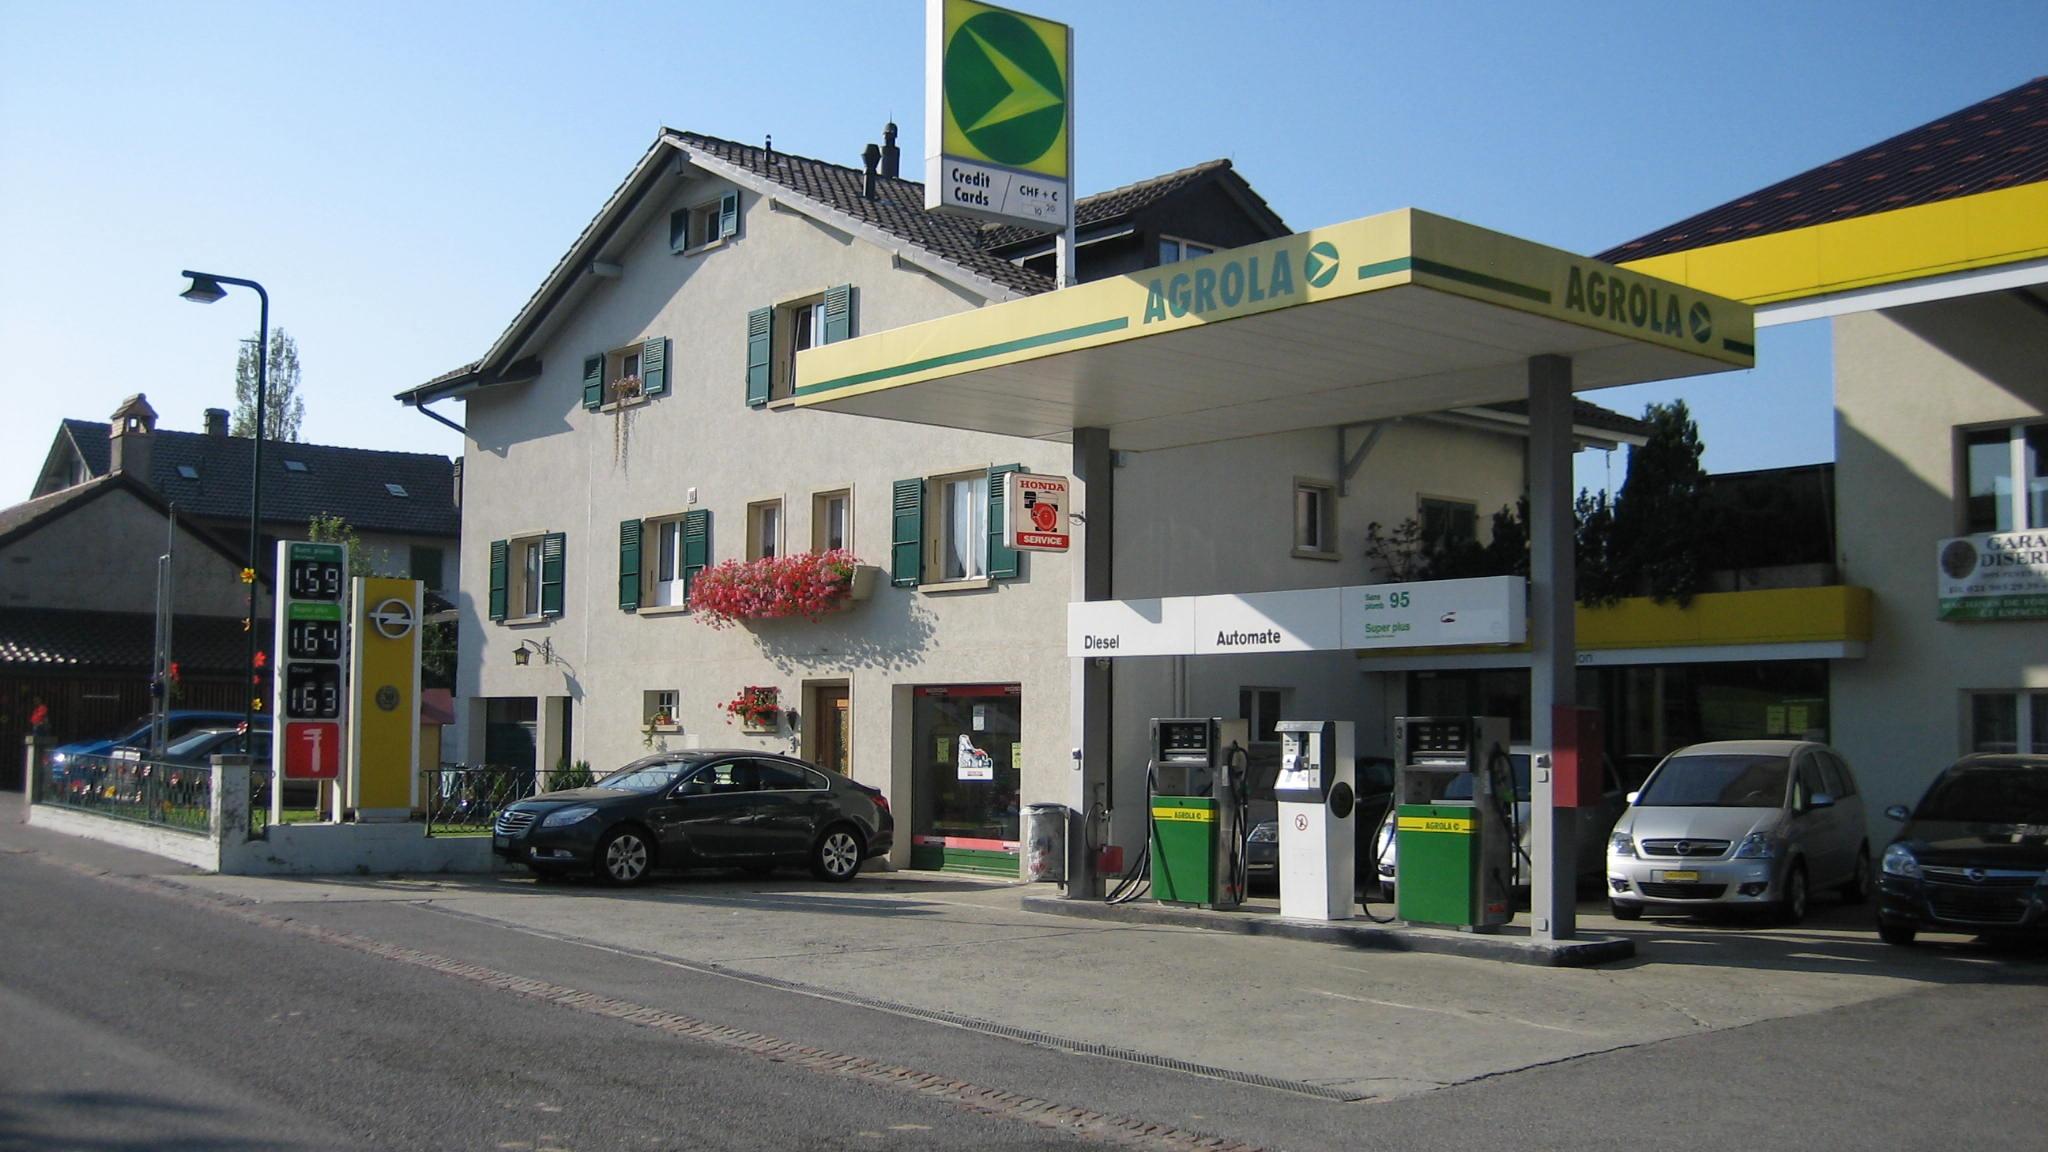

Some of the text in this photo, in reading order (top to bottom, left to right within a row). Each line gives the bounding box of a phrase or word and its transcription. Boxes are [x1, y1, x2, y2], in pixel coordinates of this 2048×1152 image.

[952, 168, 990, 188] Credit
[954, 187, 989, 206] Cards
[1020, 185, 1040, 198] CHF
[1143, 249, 1295, 325] AGROLA
[1565, 266, 1683, 338] AGROLA
[1019, 480, 1065, 492] HONDA
[1023, 534, 1063, 545] SERVICE
[1986, 534, 2048, 551] GARA
[295, 567, 339, 593] 1.59
[1389, 591, 1411, 608] 95
[1365, 621, 1411, 635] Super plus
[293, 626, 338, 652] 1.64
[1084, 634, 1120, 650] Diesel
[1216, 628, 1281, 646] Automate
[291, 686, 336, 713] 1.63
[1425, 821, 1452, 831] AGROLA
